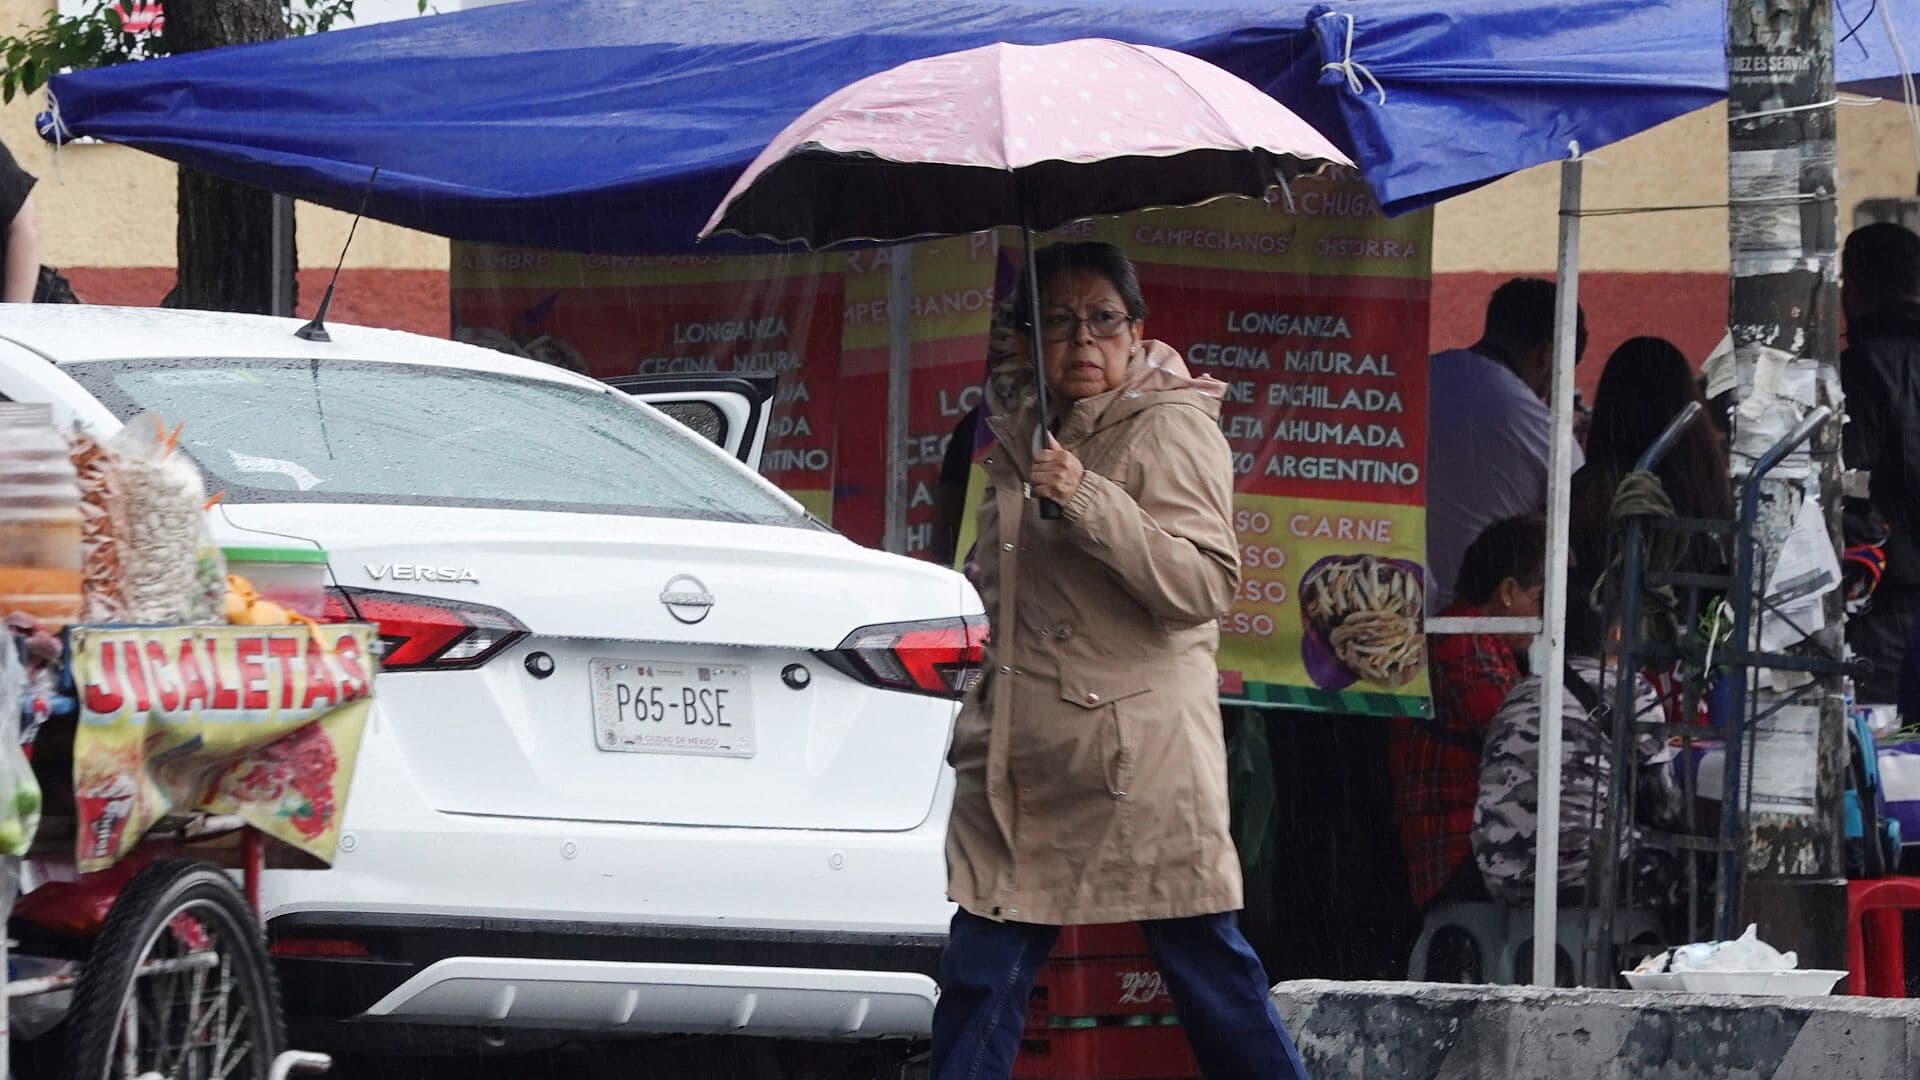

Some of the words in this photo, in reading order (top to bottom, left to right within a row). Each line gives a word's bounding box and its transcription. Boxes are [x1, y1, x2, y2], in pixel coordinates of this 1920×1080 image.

[1135, 225, 1288, 252] CAMPECHANOS
[1316, 239, 1416, 257] CHISTORRA
[461, 253, 549, 270] ALAMBRE
[673, 316, 788, 344] LONGANZA
[1228, 311, 1352, 338] LONGANZA
[1188, 343, 1270, 370] CECINA
[1284, 351, 1397, 377] NATURAL
[1268, 383, 1404, 413] ENCHILADA
[1273, 420, 1405, 449] AHUMADA
[1264, 454, 1419, 486] ARGENTINO
[1290, 514, 1393, 543] CARNE
[1238, 545, 1285, 570] SO
[365, 564, 480, 584] VERSA
[84, 634, 372, 716] JICALETAS
[616, 683, 732, 728] P65-BSE
